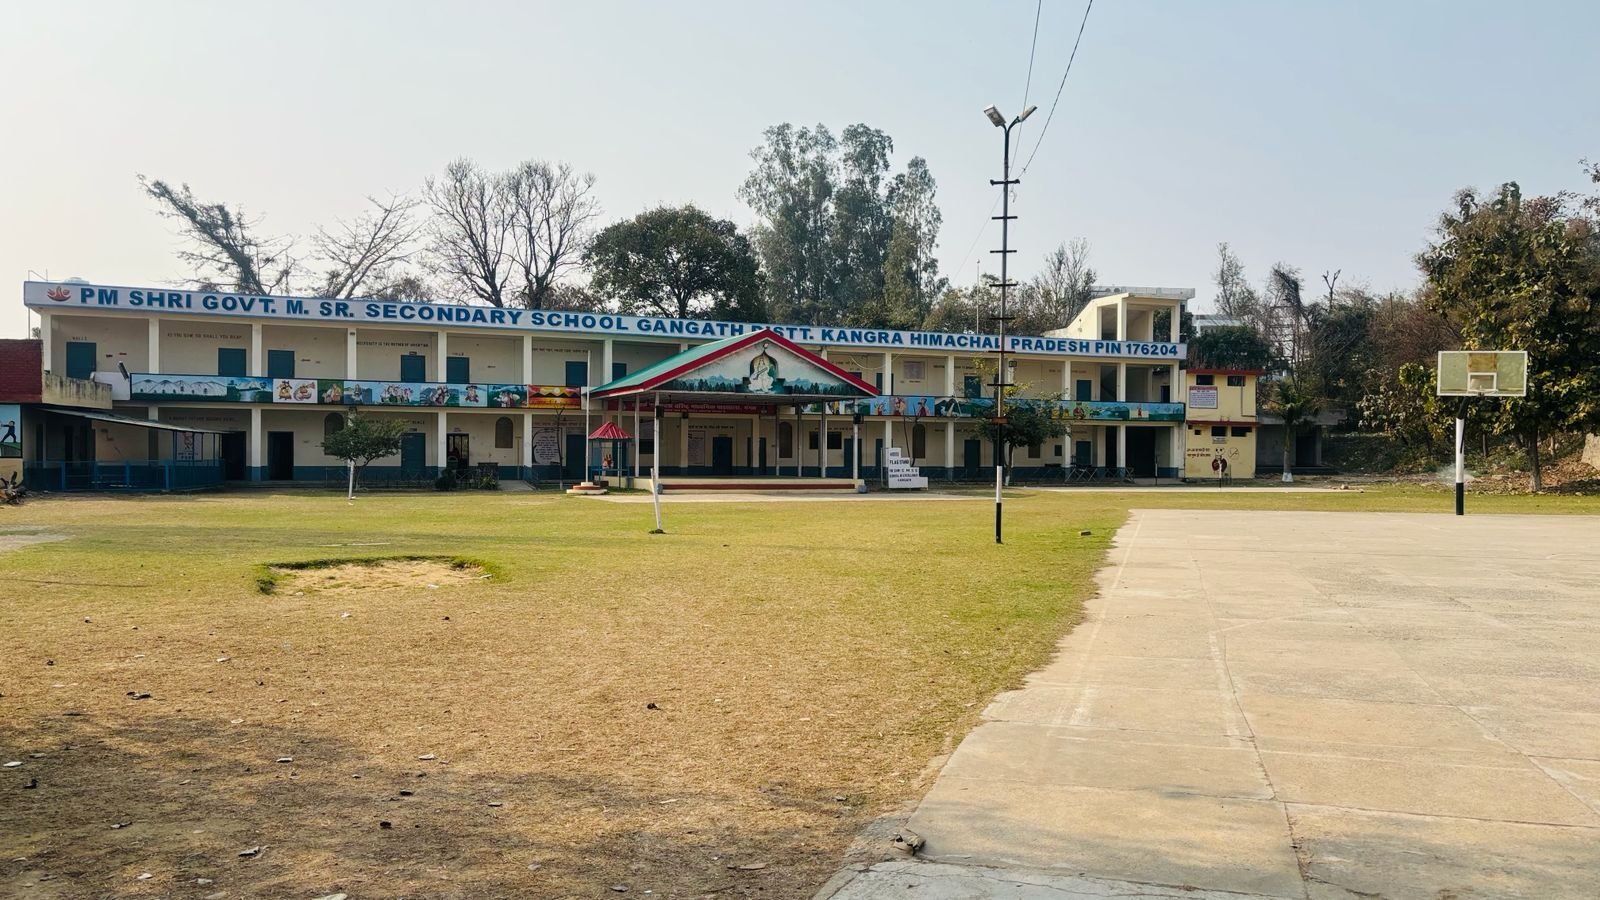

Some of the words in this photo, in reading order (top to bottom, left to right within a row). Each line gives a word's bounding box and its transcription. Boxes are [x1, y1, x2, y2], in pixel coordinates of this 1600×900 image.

[80, 287, 118, 305] PM
[129, 290, 192, 309] SHRI
[202, 295, 276, 314] GOVT.
[286, 300, 309, 315] M.
[319, 302, 354, 318] SR.
[365, 303, 523, 325] SECONDARY
[531, 312, 629, 331] SCHOOL
[637, 318, 744, 336] GANGATH
[752, 325, 814, 340] STT.
[821, 329, 903, 344] KANGRA
[910, 333, 1001, 349] HIMACHAL
[1011, 338, 1090, 353] PRADESH
[1095, 341, 1122, 354] PIN
[1126, 343, 1178, 356] 176204
